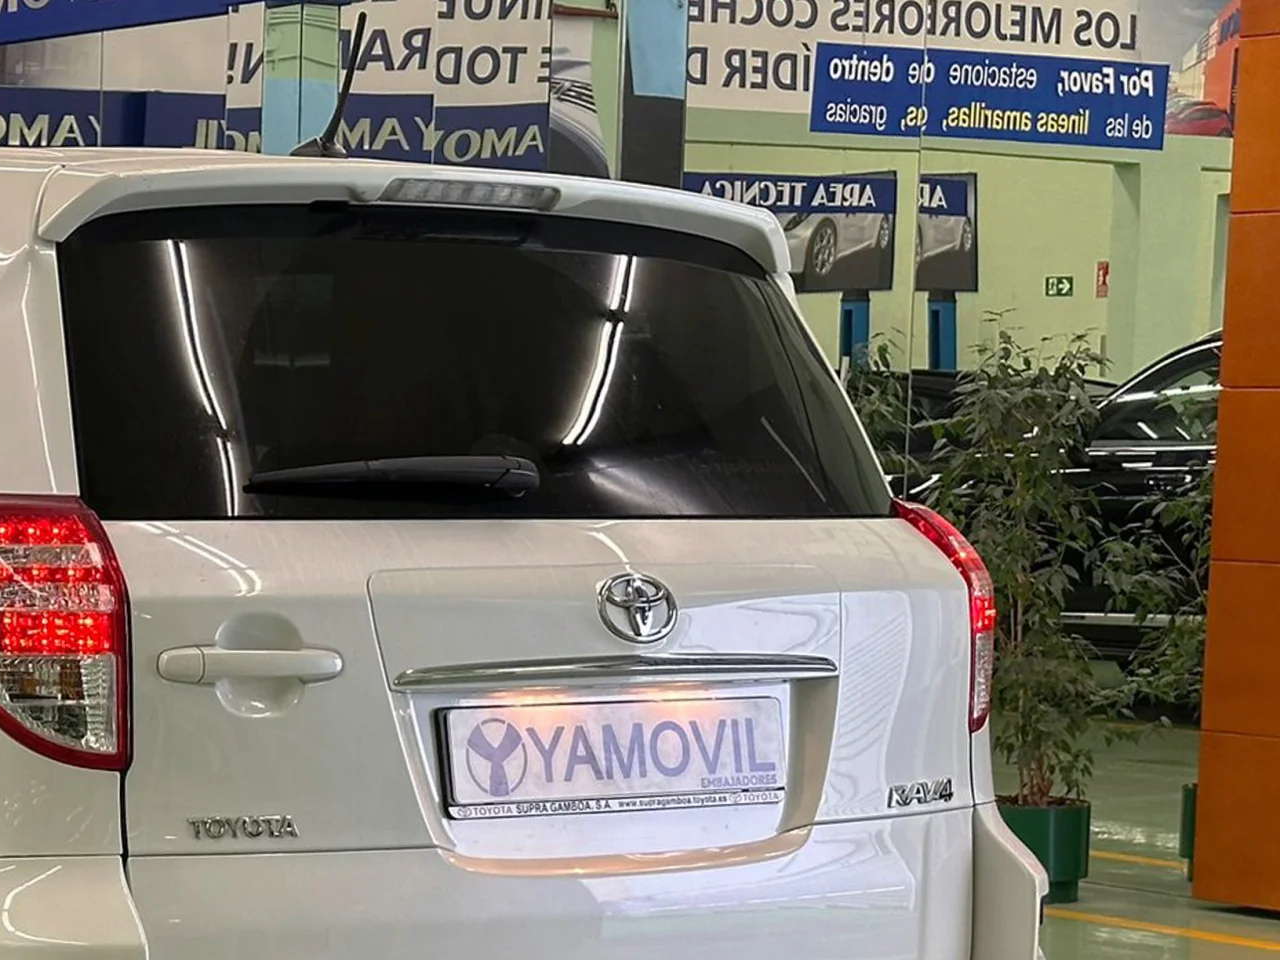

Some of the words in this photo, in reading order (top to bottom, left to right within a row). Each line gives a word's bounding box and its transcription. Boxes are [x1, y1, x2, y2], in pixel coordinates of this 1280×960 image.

[526, 717, 776, 783] YAMOVIL
[700, 773, 778, 789] EMBAJADORES
[886, 776, 954, 809] RAV4
[474, 806, 513, 817] TOYOTA
[186, 814, 300, 840] TOYOTA
